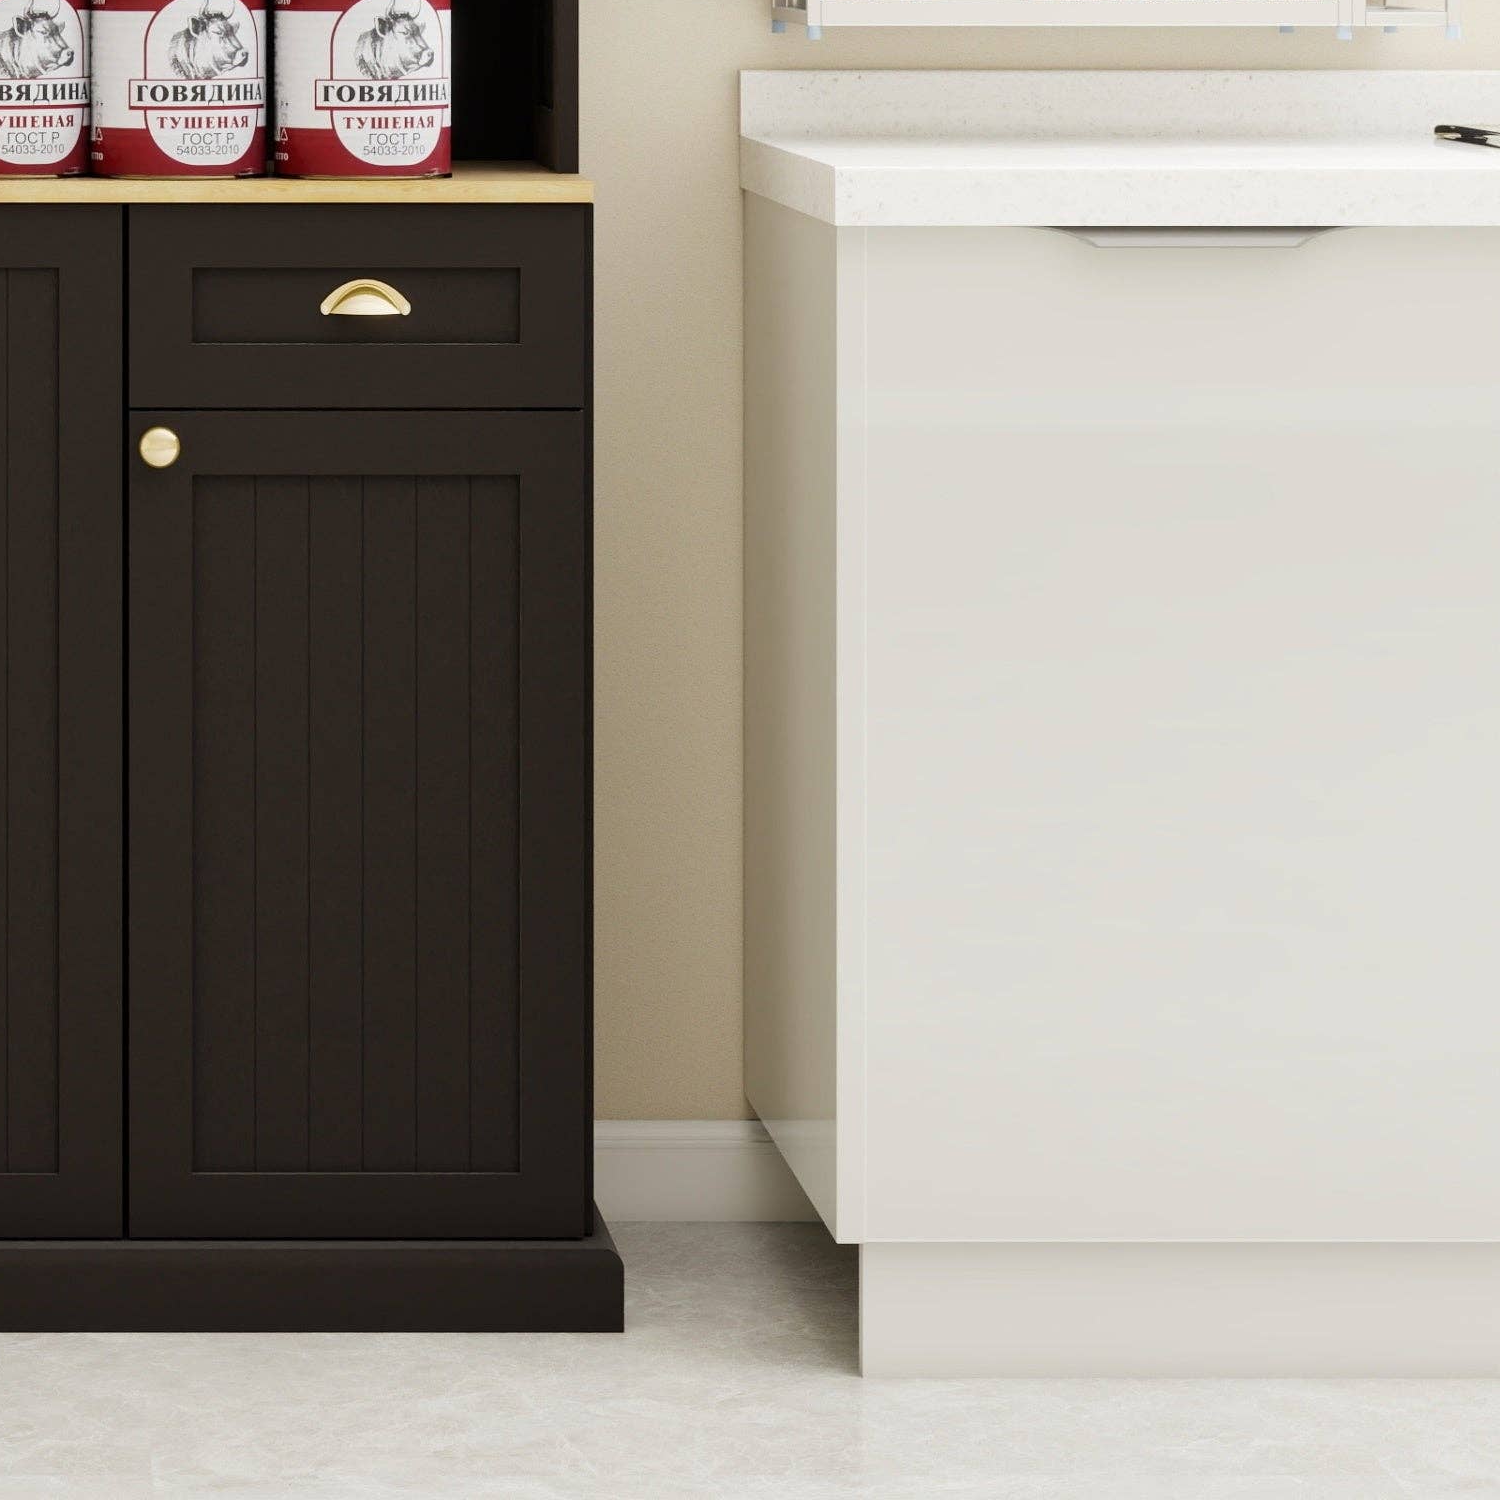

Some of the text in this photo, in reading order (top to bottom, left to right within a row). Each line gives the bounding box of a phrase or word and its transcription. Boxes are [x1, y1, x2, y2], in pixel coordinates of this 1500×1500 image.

[136, 83, 262, 105] ГОВЯДИНА
[323, 83, 447, 104] ГОВЯДИНА
[157, 115, 249, 129] ТУШЕНАЯ
[343, 115, 435, 129] ТУШЕНАЯ
[7, 131, 60, 145] ГОСТ Р
[182, 132, 235, 145] ГОСТ Р
[368, 132, 421, 146] ГОСТ Р
[1, 144, 65, 155] 54033-2010
[176, 145, 240, 156] 54033-2010
[363, 145, 426, 156] 54033-2010
